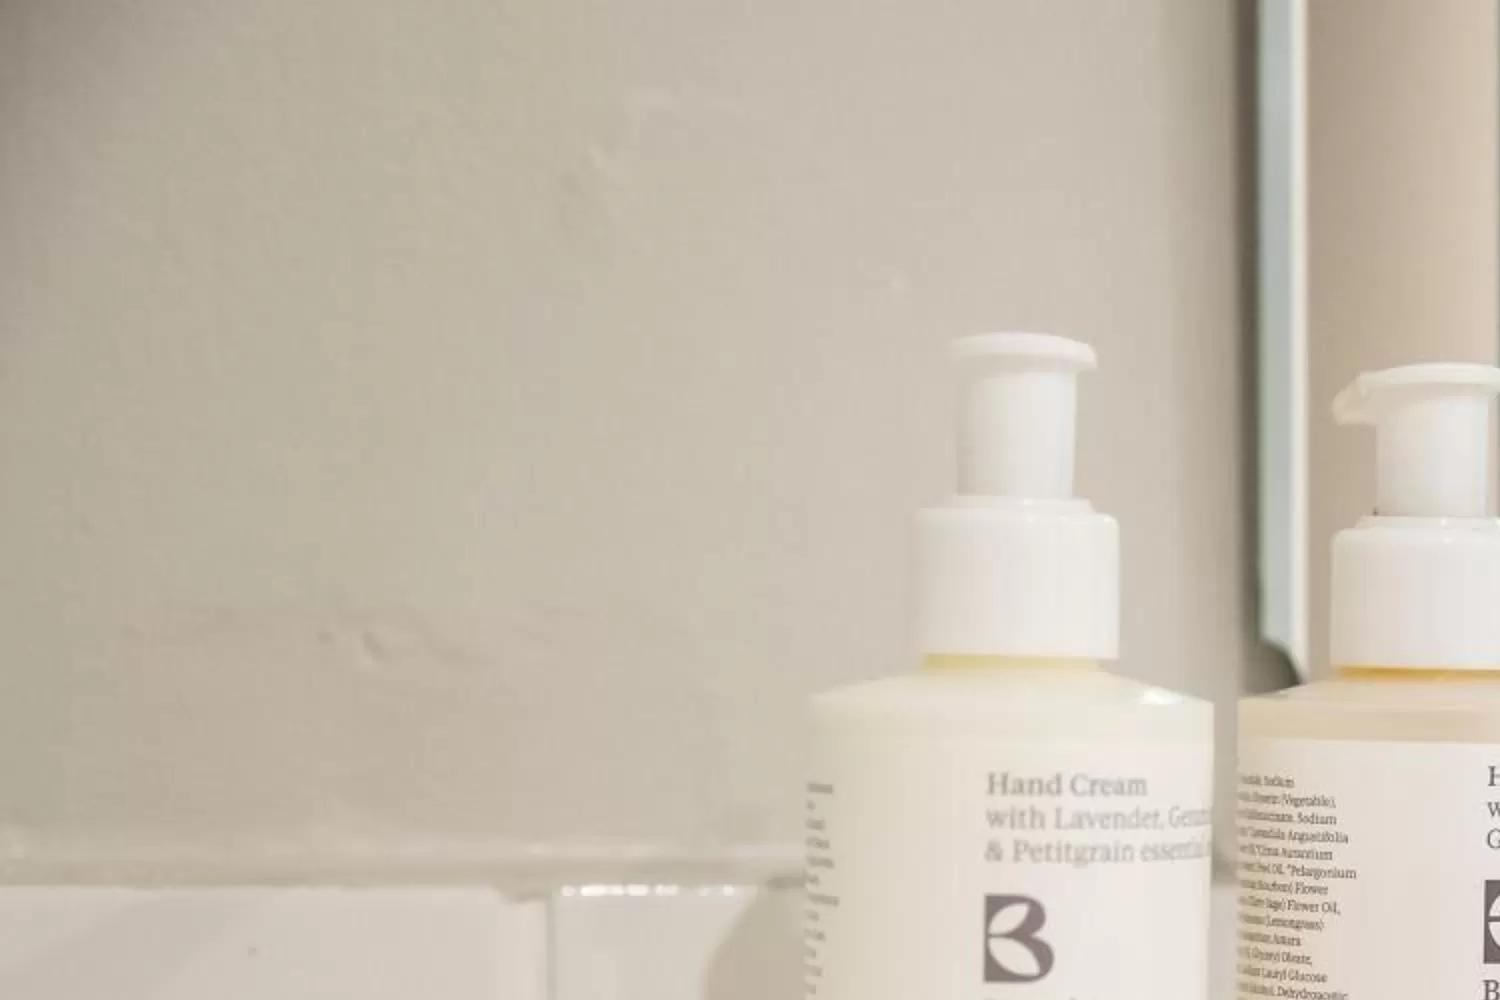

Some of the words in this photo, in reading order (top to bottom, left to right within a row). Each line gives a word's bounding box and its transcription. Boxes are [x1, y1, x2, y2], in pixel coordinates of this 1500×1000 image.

[985, 772, 1062, 798] Hand
[1069, 772, 1148, 798] Cream
[985, 805, 1045, 831] with
[1297, 810, 1338, 826] Sodium
[984, 839, 1003, 864] &
[1012, 839, 1135, 869] Petitgrain
